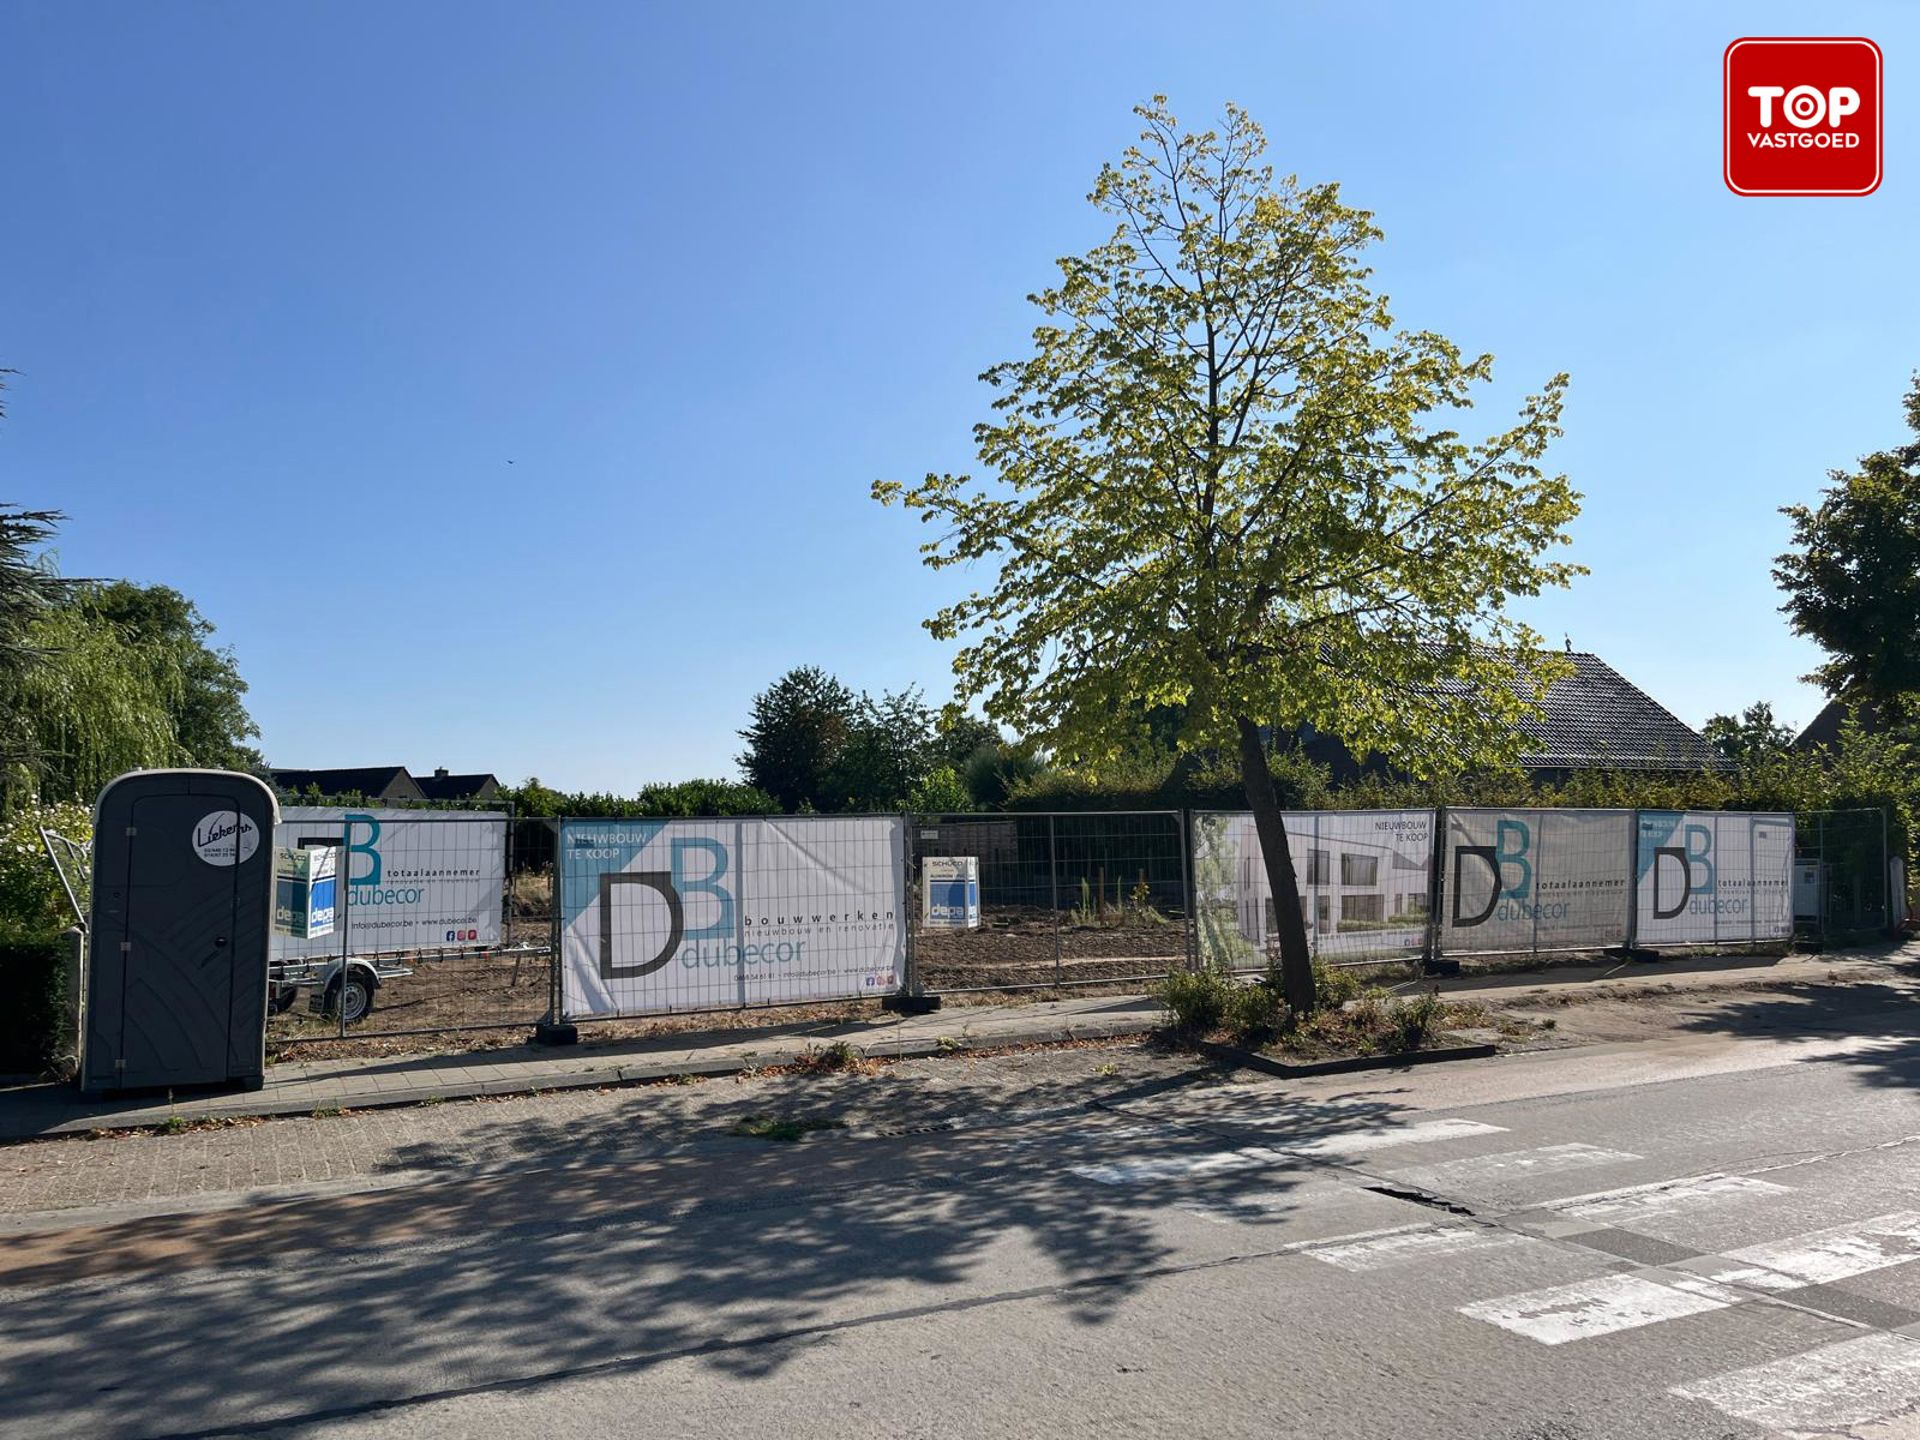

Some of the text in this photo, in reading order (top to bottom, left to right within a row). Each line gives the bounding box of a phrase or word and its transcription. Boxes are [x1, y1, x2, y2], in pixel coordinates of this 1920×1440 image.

[1375, 821, 1427, 831] NIEUWBOUW
[567, 832, 647, 845] NIEUWBOUW
[1395, 832, 1429, 842] TE KOOP
[567, 848, 620, 860] TE KOOP
[387, 868, 480, 877] totaalaannemer
[1536, 880, 1624, 890] totaalaannemer
[347, 885, 424, 906] dubecor
[931, 903, 964, 919] depa
[1498, 898, 1571, 921] dubecor
[1690, 894, 1748, 914] dubecor
[744, 910, 894, 926] bouwwerken
[744, 926, 812, 937] nieuwbouw
[838, 922, 894, 933] renovatie
[682, 938, 806, 969] dubecor
